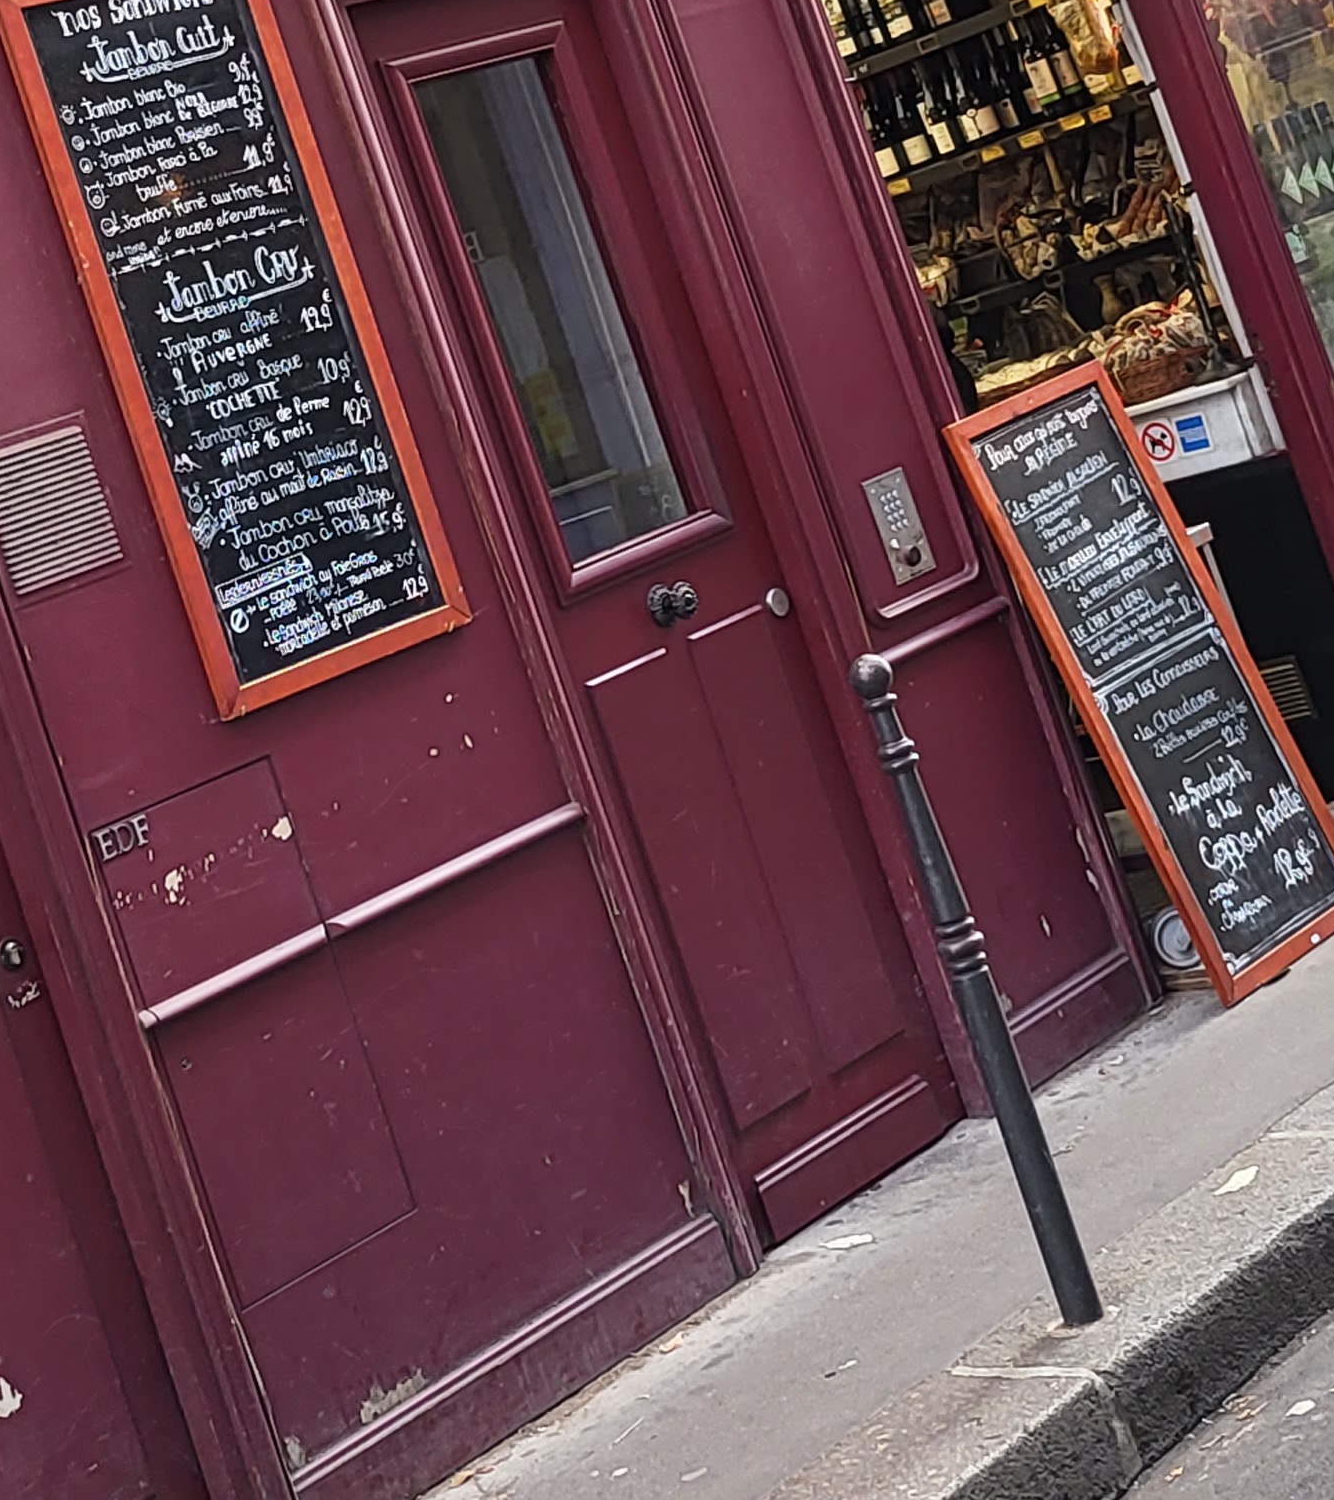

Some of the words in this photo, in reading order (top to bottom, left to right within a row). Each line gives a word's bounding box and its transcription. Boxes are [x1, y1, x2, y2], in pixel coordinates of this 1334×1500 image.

[87, 30, 176, 74] Jambon
[80, 97, 134, 121] Jambon
[134, 88, 166, 107] blanc
[164, 79, 187, 99] Bio
[90, 120, 141, 146] Jambon
[144, 109, 174, 130] blanc
[99, 143, 147, 169] Jambon
[147, 133, 175, 154] blanc
[105, 163, 156, 188] Jambon
[121, 206, 170, 230] Jambon
[157, 228, 172, 245] et
[163, 260, 256, 311] Jambon
[160, 333, 212, 360] Jambon
[174, 378, 228, 406] Jambon
[192, 423, 248, 451] Jambon
[276, 403, 292, 423] de
[282, 420, 314, 443] mois
[209, 469, 268, 499] Jambon
[260, 489, 280, 507] au
[307, 470, 322, 488] de
[226, 514, 294, 549] Jambon
[239, 552, 258, 572] du
[258, 532, 317, 562] Cochon
[320, 522, 333, 541] à
[330, 614, 342, 631] et
[1216, 798, 1242, 819] la
[95, 815, 149, 862] EDF
